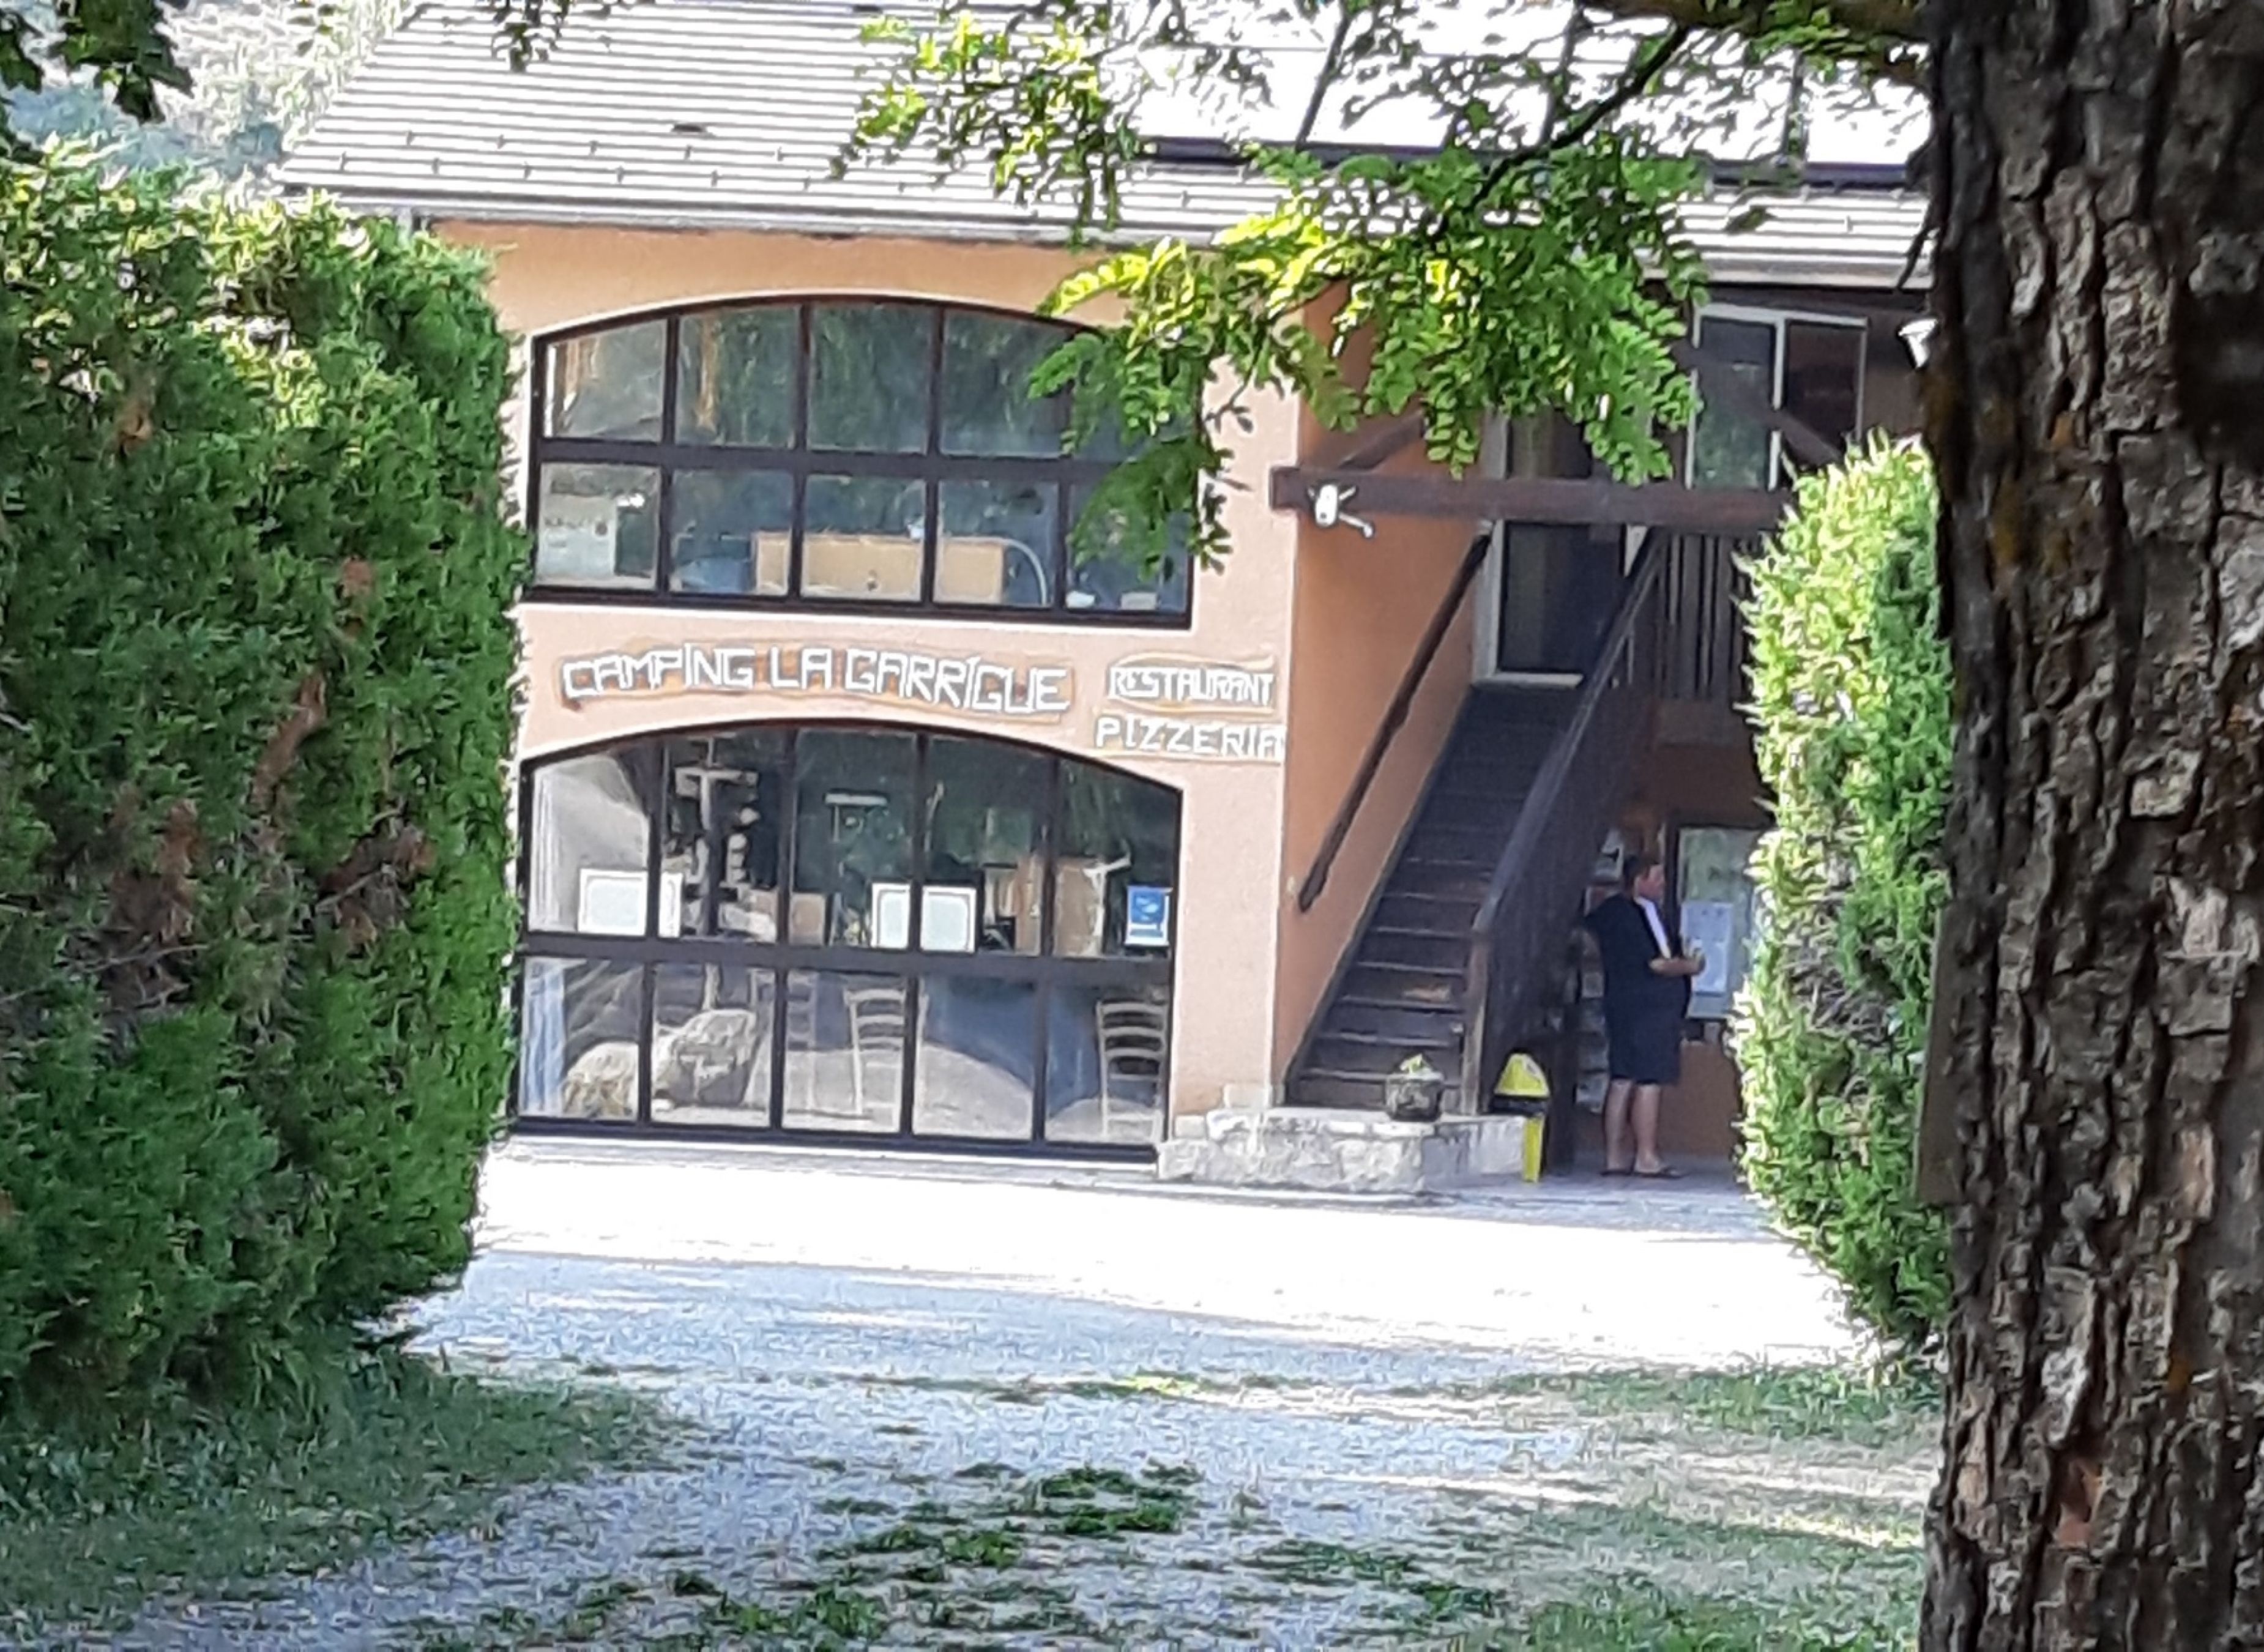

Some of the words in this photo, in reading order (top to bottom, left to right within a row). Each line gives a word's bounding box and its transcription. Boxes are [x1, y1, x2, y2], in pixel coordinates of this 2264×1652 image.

[562, 643, 755, 698] CAMPING
[770, 646, 833, 689] LA
[1095, 713, 1287, 760] PIZZERIA
